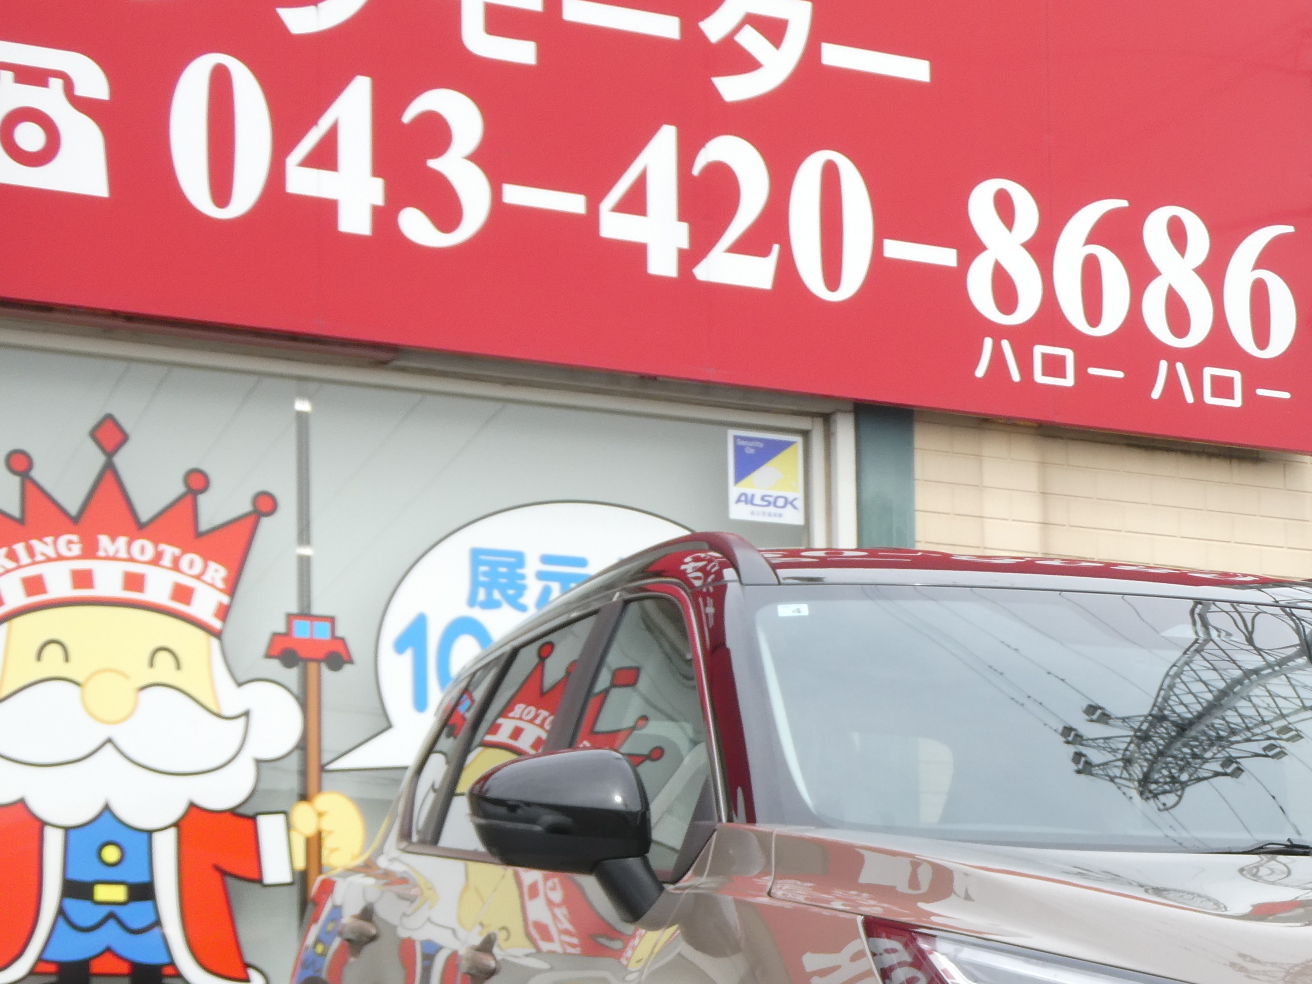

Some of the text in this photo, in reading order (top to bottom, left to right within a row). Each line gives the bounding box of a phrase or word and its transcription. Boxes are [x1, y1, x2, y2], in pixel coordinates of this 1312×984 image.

[275, 0, 932, 102] モーター
[974, 336, 1292, 408] ハロー ハロー
[735, 492, 800, 511] ALSOK
[96, 534, 229, 589] MOTOR
